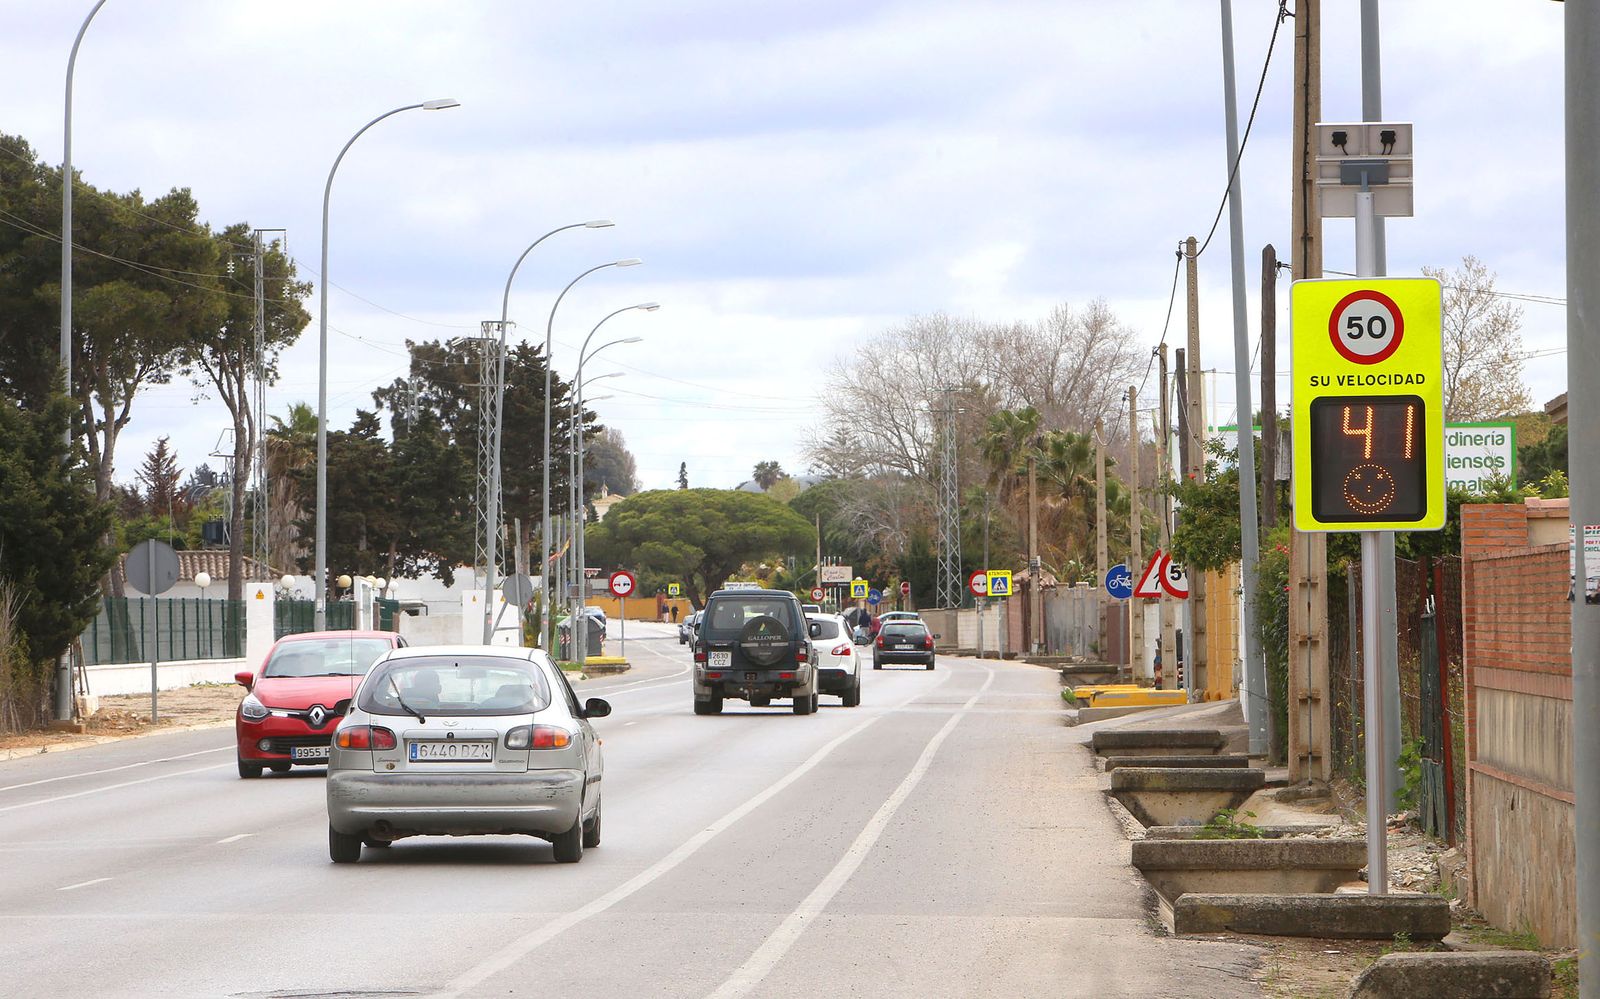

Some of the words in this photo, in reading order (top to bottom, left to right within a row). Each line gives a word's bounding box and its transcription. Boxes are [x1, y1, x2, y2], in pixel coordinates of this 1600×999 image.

[1346, 315, 1387, 340] 50
[1310, 375, 1331, 387] SU
[1336, 373, 1426, 387] VELOCIDAD
[1342, 405, 1414, 459] 41
[1446, 430, 1505, 446] dinería
[1170, 565, 1187, 581] 5
[297, 748, 321, 757] 9955
[324, 747, 331, 757] H
[420, 744, 457, 758] 6440
